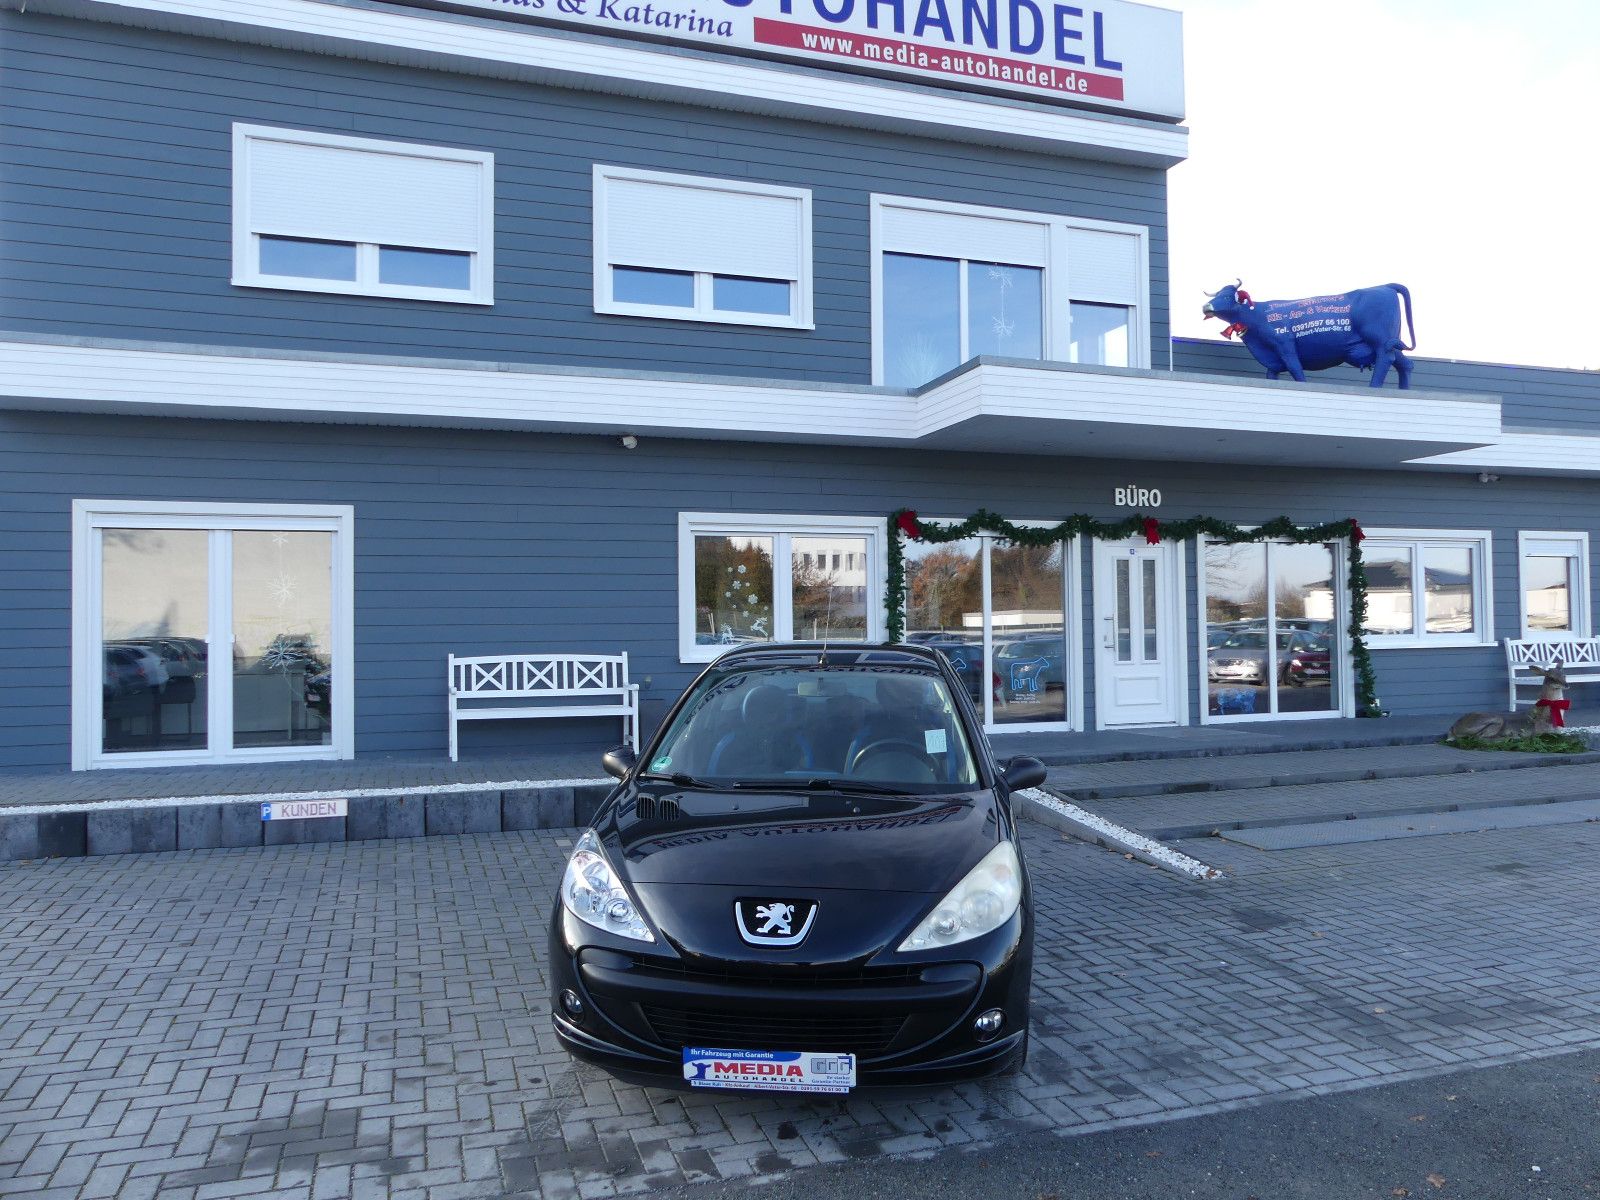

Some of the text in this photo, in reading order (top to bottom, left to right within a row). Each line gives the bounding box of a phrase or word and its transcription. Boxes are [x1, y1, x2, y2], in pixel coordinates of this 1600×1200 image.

[596, 0, 734, 37] Katarina
[721, 0, 1123, 72] HANDEL
[801, 31, 1088, 93] www.media-autohandel.de
[1291, 319, 1324, 333] 0391/597
[1115, 484, 1162, 507] BÜRO
[263, 802, 337, 818] P KUNDEN
[701, 1049, 732, 1059] Fahrzeug
[714, 1062, 804, 1077] MEDIA
[714, 1074, 804, 1083] AUTOHANDEL
